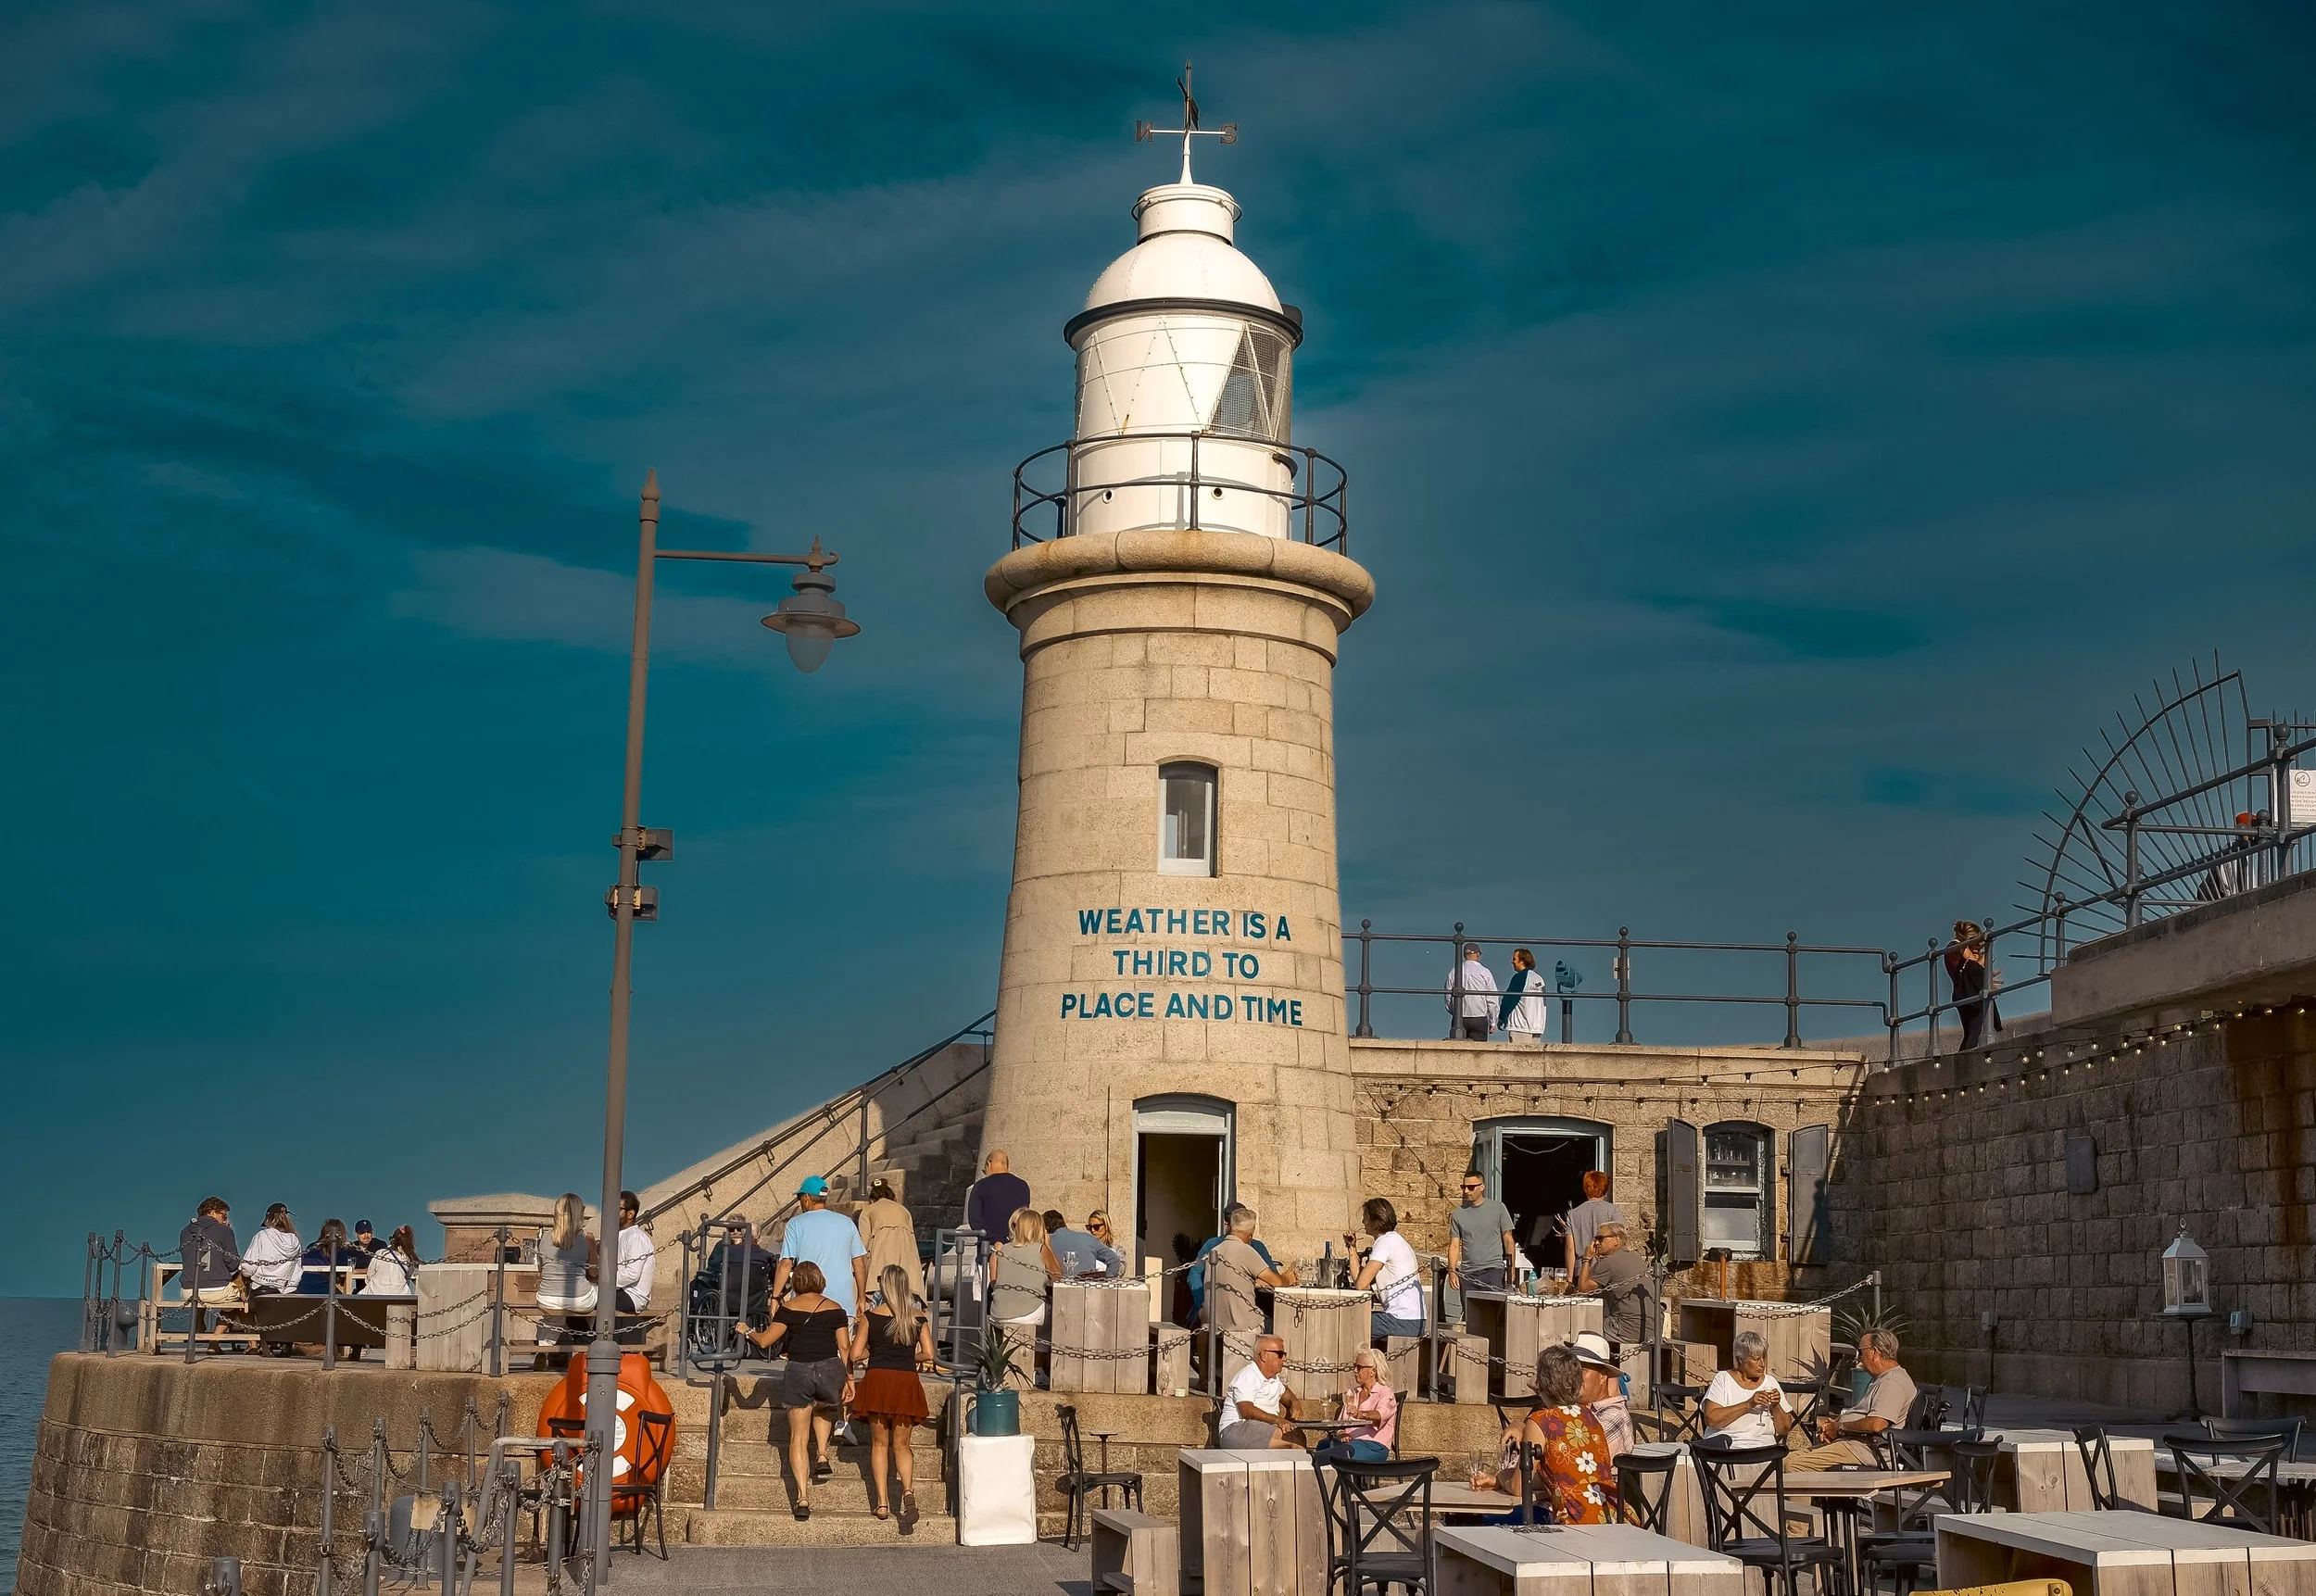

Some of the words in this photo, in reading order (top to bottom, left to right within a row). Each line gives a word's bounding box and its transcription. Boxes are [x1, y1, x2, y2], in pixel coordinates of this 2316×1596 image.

[1078, 908, 1230, 936] WEATHER
[1242, 912, 1266, 939] IS
[1276, 915, 1291, 941] A
[1113, 950, 1212, 977] THIRD
[1222, 952, 1259, 979] TO
[1061, 992, 1154, 1019] PLACE
[1165, 992, 1234, 1020] AND
[1241, 995, 1303, 1026] TIME
